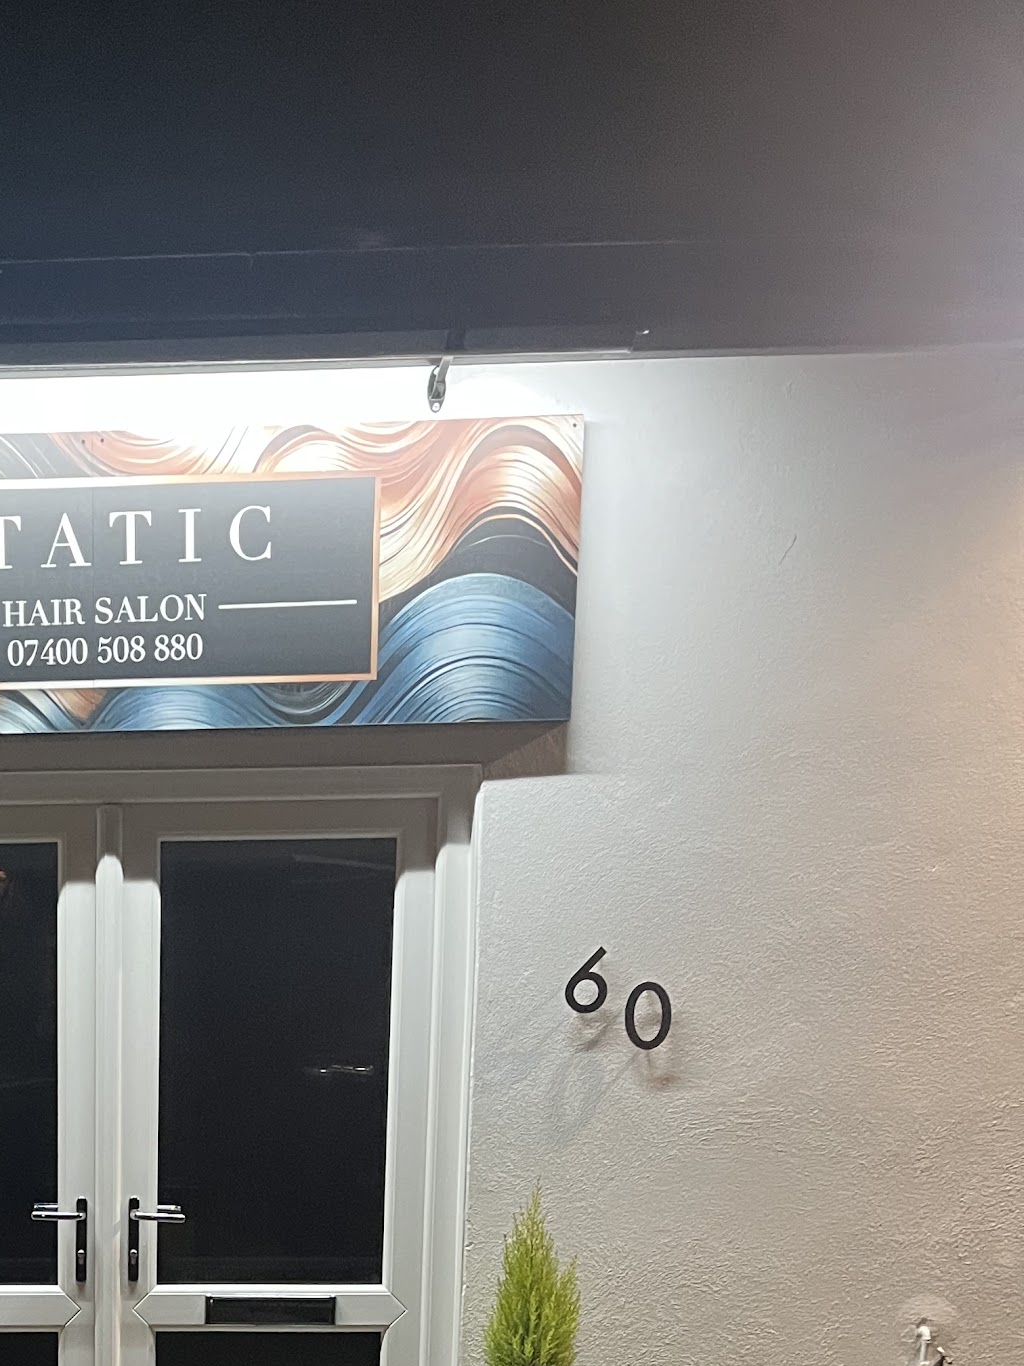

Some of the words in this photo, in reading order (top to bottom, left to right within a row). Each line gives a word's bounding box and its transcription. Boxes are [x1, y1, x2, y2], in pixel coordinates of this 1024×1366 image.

[2, 599, 86, 628] HAIR
[94, 594, 207, 626] SALON
[7, 637, 89, 667] 07400
[97, 635, 146, 664] 508
[154, 632, 204, 662] 880
[565, 946, 672, 1050] 60
